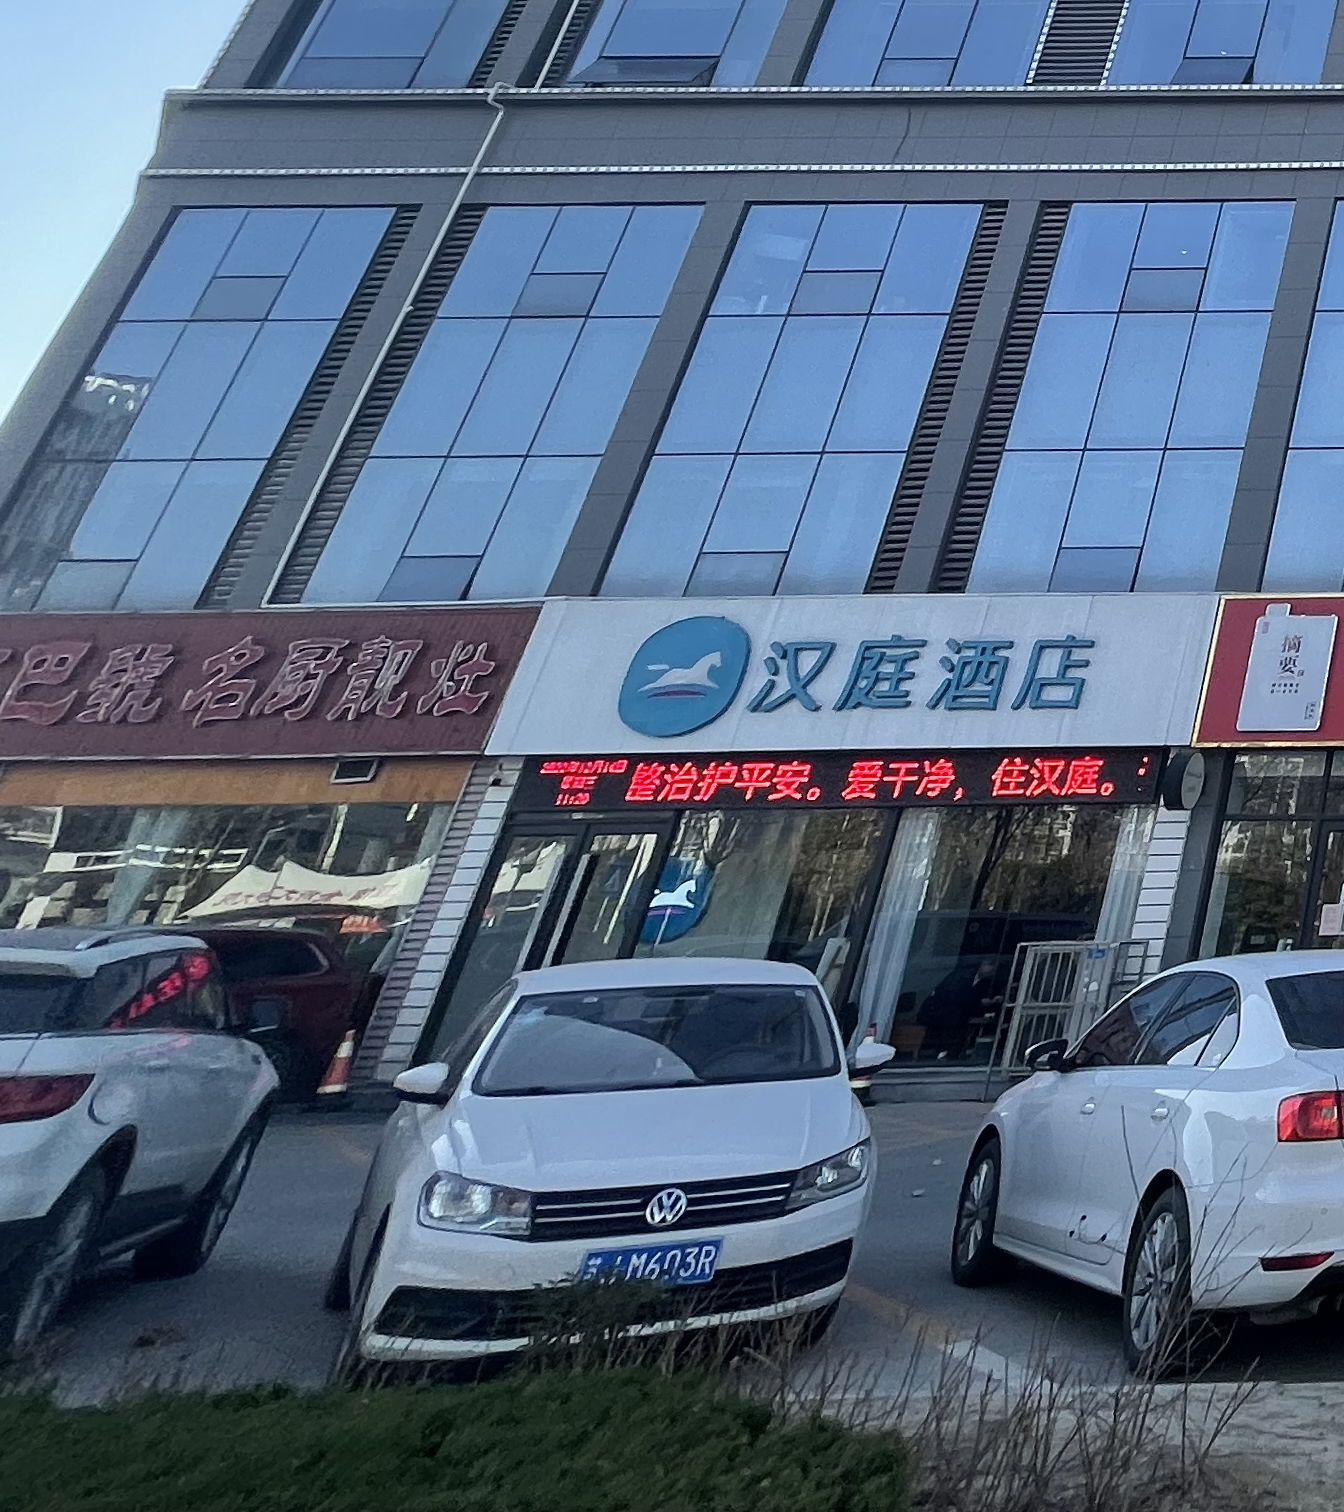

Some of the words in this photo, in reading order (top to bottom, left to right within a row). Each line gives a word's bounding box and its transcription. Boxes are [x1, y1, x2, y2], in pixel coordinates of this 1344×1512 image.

[0, 641, 175, 726] 巴號
[747, 635, 1094, 712] 汉庭酒店
